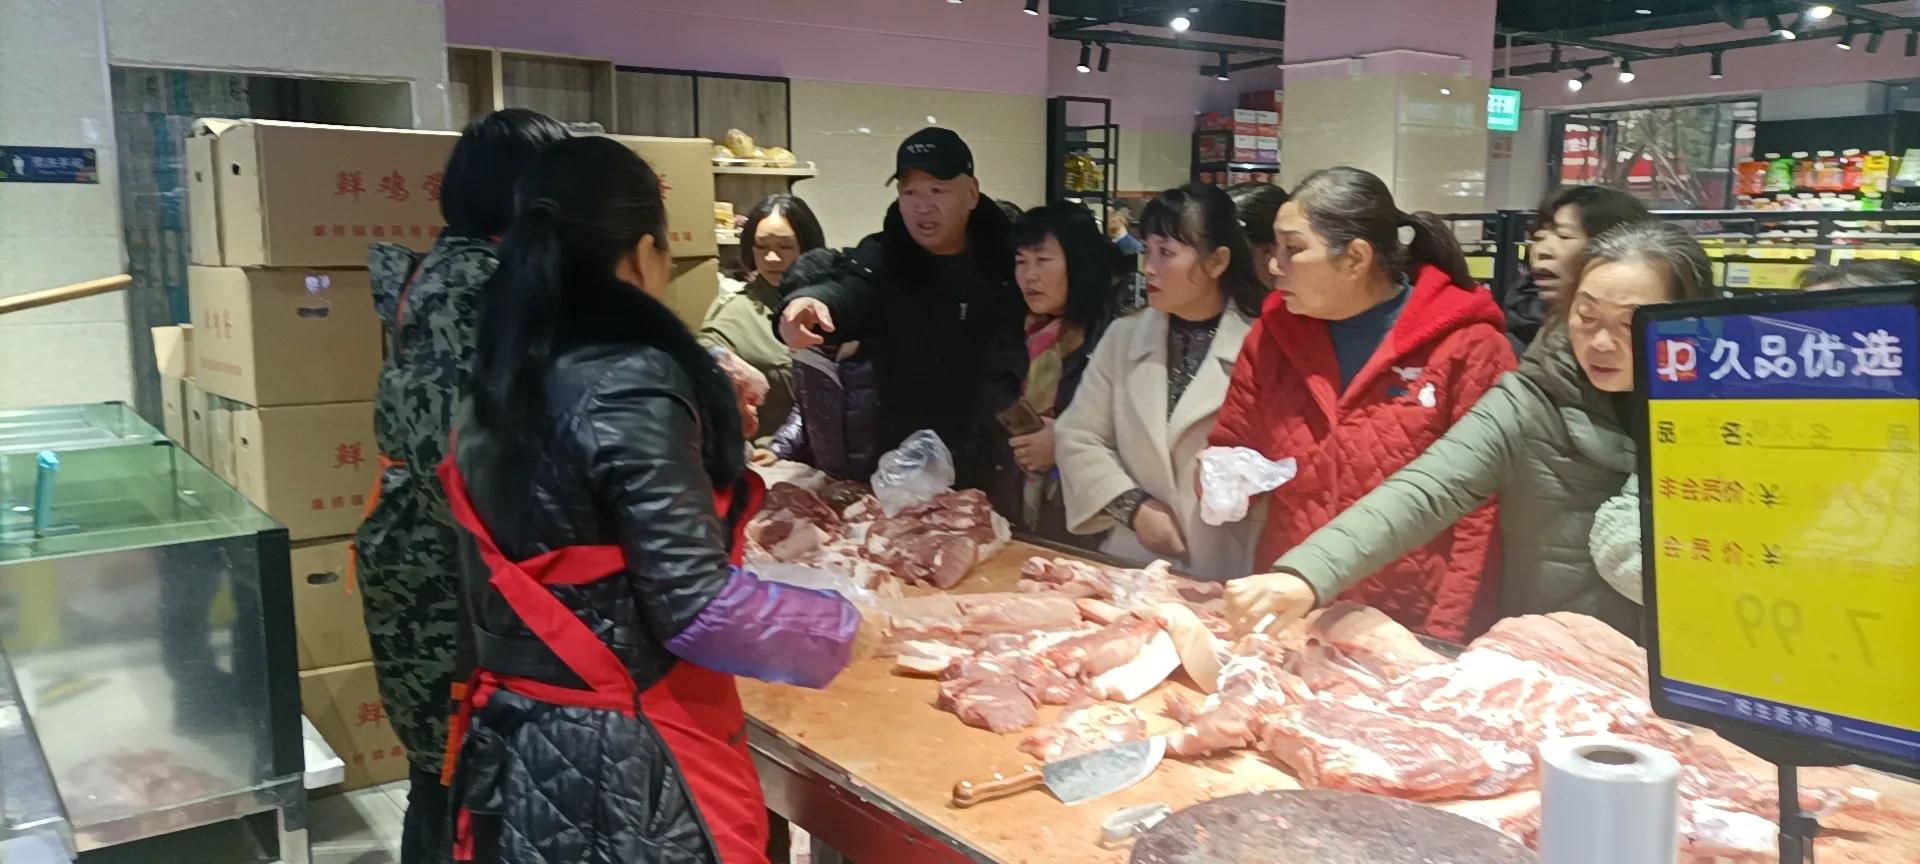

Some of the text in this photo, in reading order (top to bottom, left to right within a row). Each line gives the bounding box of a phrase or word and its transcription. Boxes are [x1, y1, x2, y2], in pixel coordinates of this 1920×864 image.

[1709, 329, 1903, 380] 久品优选
[333, 441, 366, 472] 鲜
